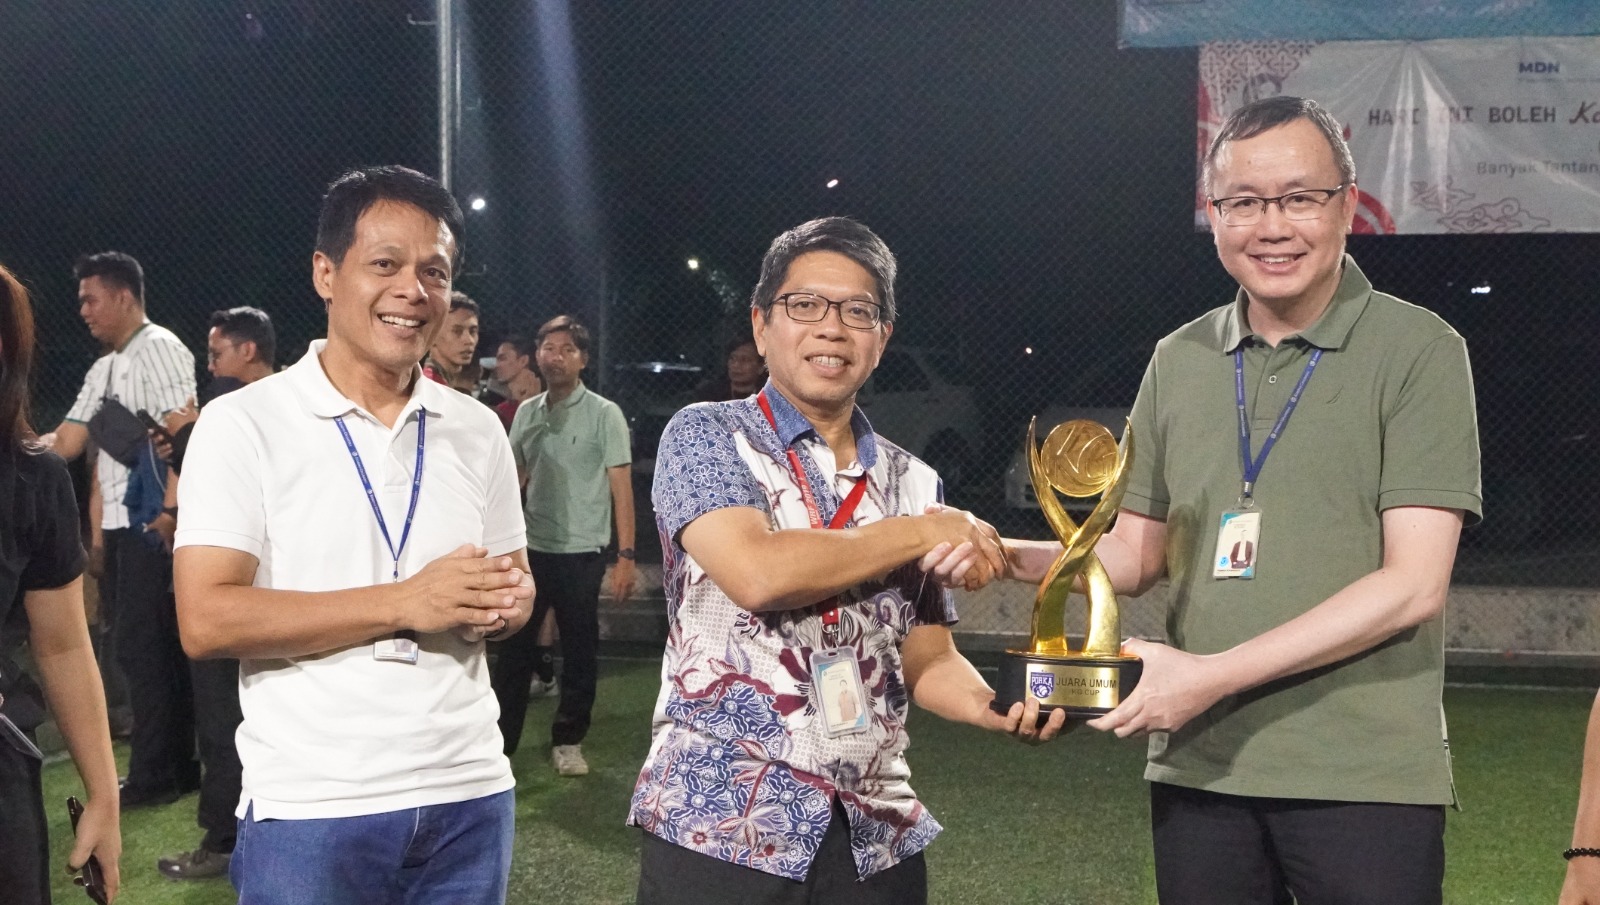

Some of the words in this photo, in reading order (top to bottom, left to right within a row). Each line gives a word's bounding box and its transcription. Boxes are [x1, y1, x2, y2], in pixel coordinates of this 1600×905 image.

[1518, 61, 1560, 74] MDN
[1437, 105, 1474, 124] NI
[1488, 105, 1557, 124] BOLEH
[1477, 160, 1537, 178] Banyak
[1031, 677, 1053, 688] PORKA
[1056, 678, 1086, 687] JUARA
[1089, 679, 1116, 688] UMUM
